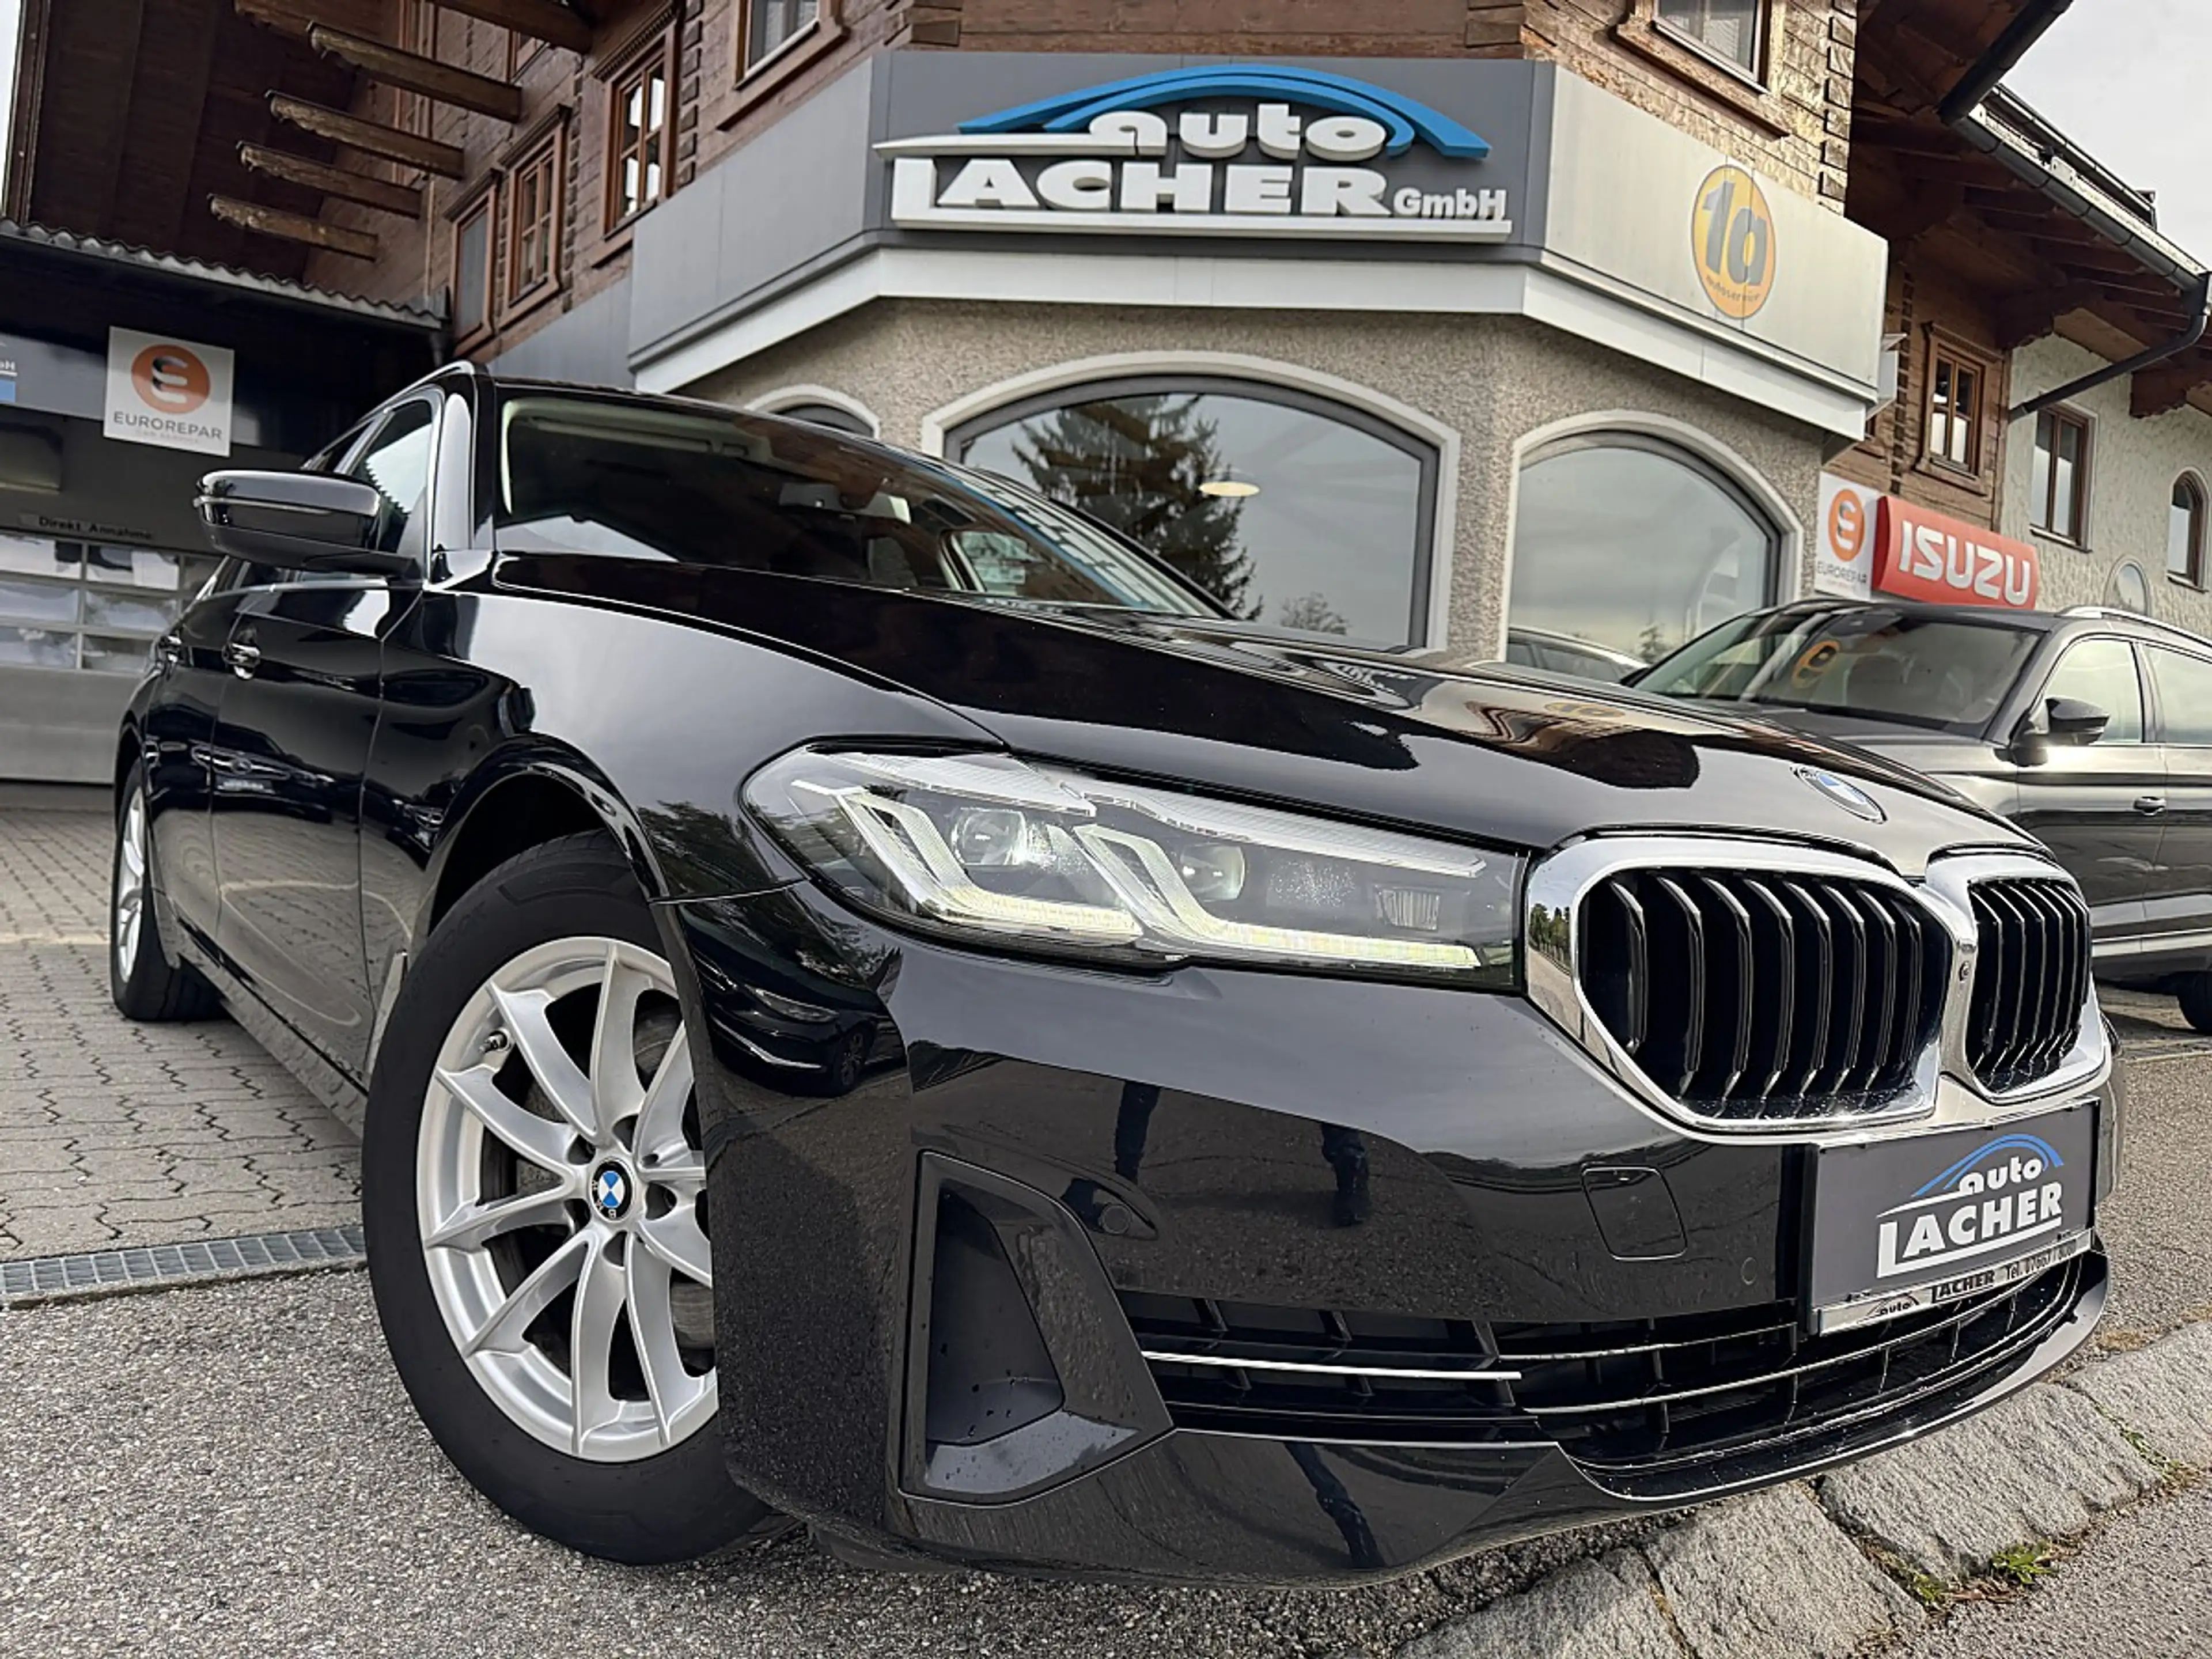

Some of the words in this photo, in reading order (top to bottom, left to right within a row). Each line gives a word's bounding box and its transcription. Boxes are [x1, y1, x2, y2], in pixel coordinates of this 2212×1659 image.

[1090, 104, 1387, 160] auto
[892, 157, 1391, 229] LACHER
[1394, 187, 1506, 221] GmbH
[113, 410, 223, 441] EUROREPAR
[1899, 520, 2031, 605] ISUZU
[1958, 1156, 2043, 1196] auto
[1876, 1181, 2062, 1278] LACHER
[1931, 1269, 1996, 1304] LACHER
